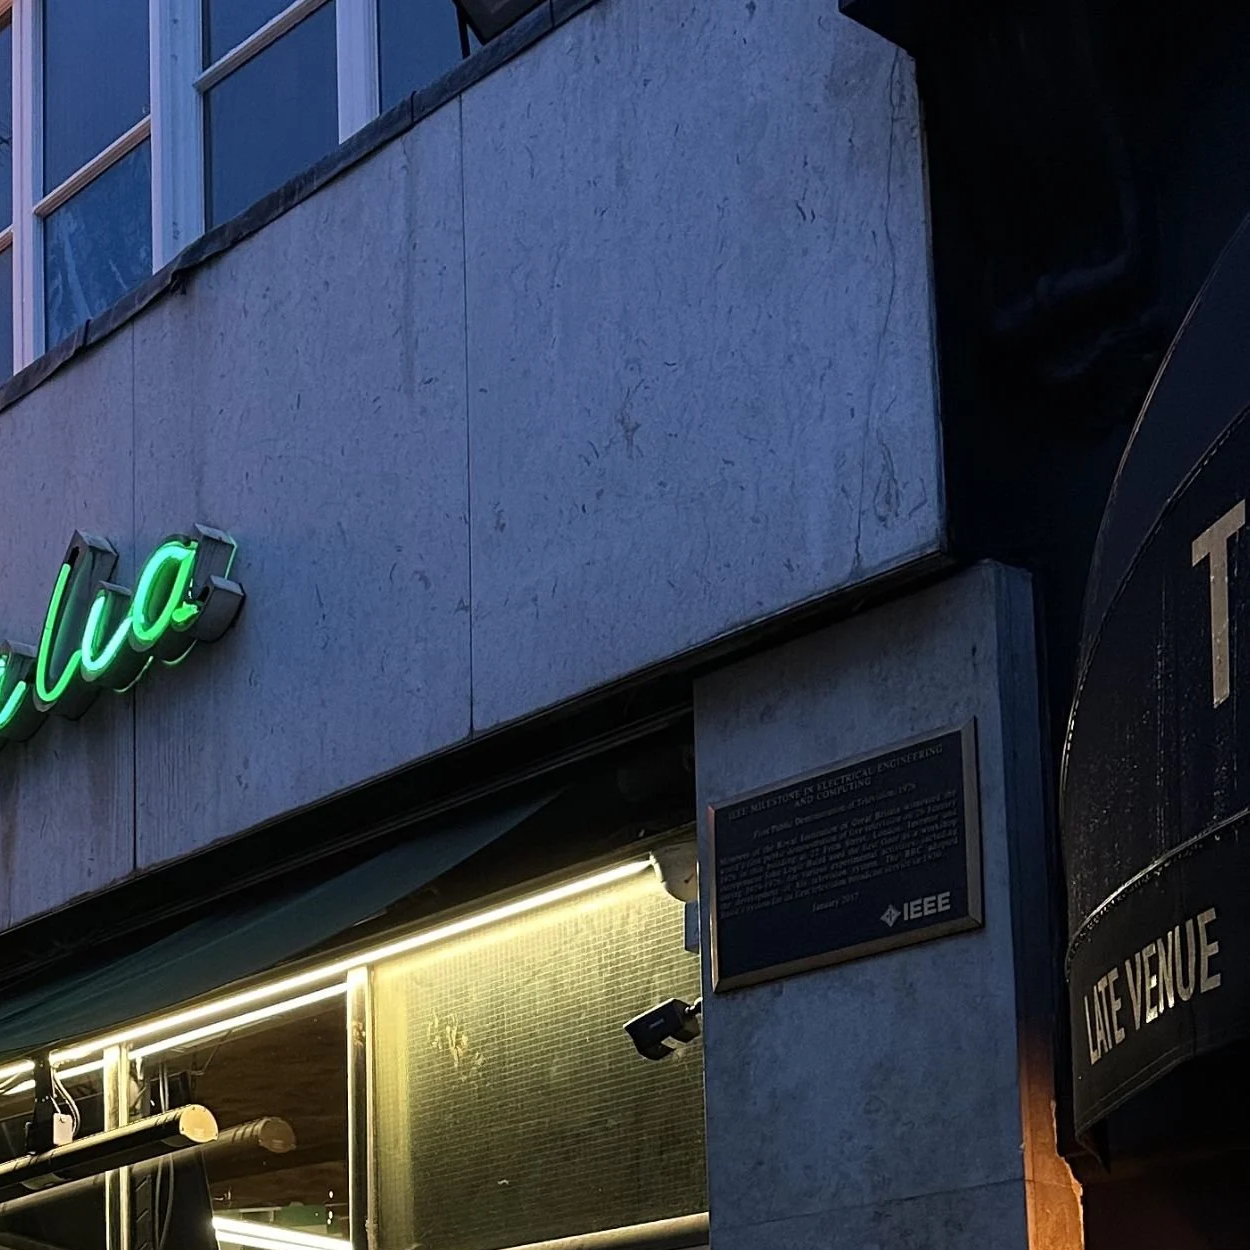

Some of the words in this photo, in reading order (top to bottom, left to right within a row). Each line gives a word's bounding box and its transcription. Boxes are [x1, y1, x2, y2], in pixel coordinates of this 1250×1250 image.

[903, 891, 951, 921] IEEE
[1083, 977, 1127, 1067] LATE
[1127, 906, 1224, 1025] VENUE
